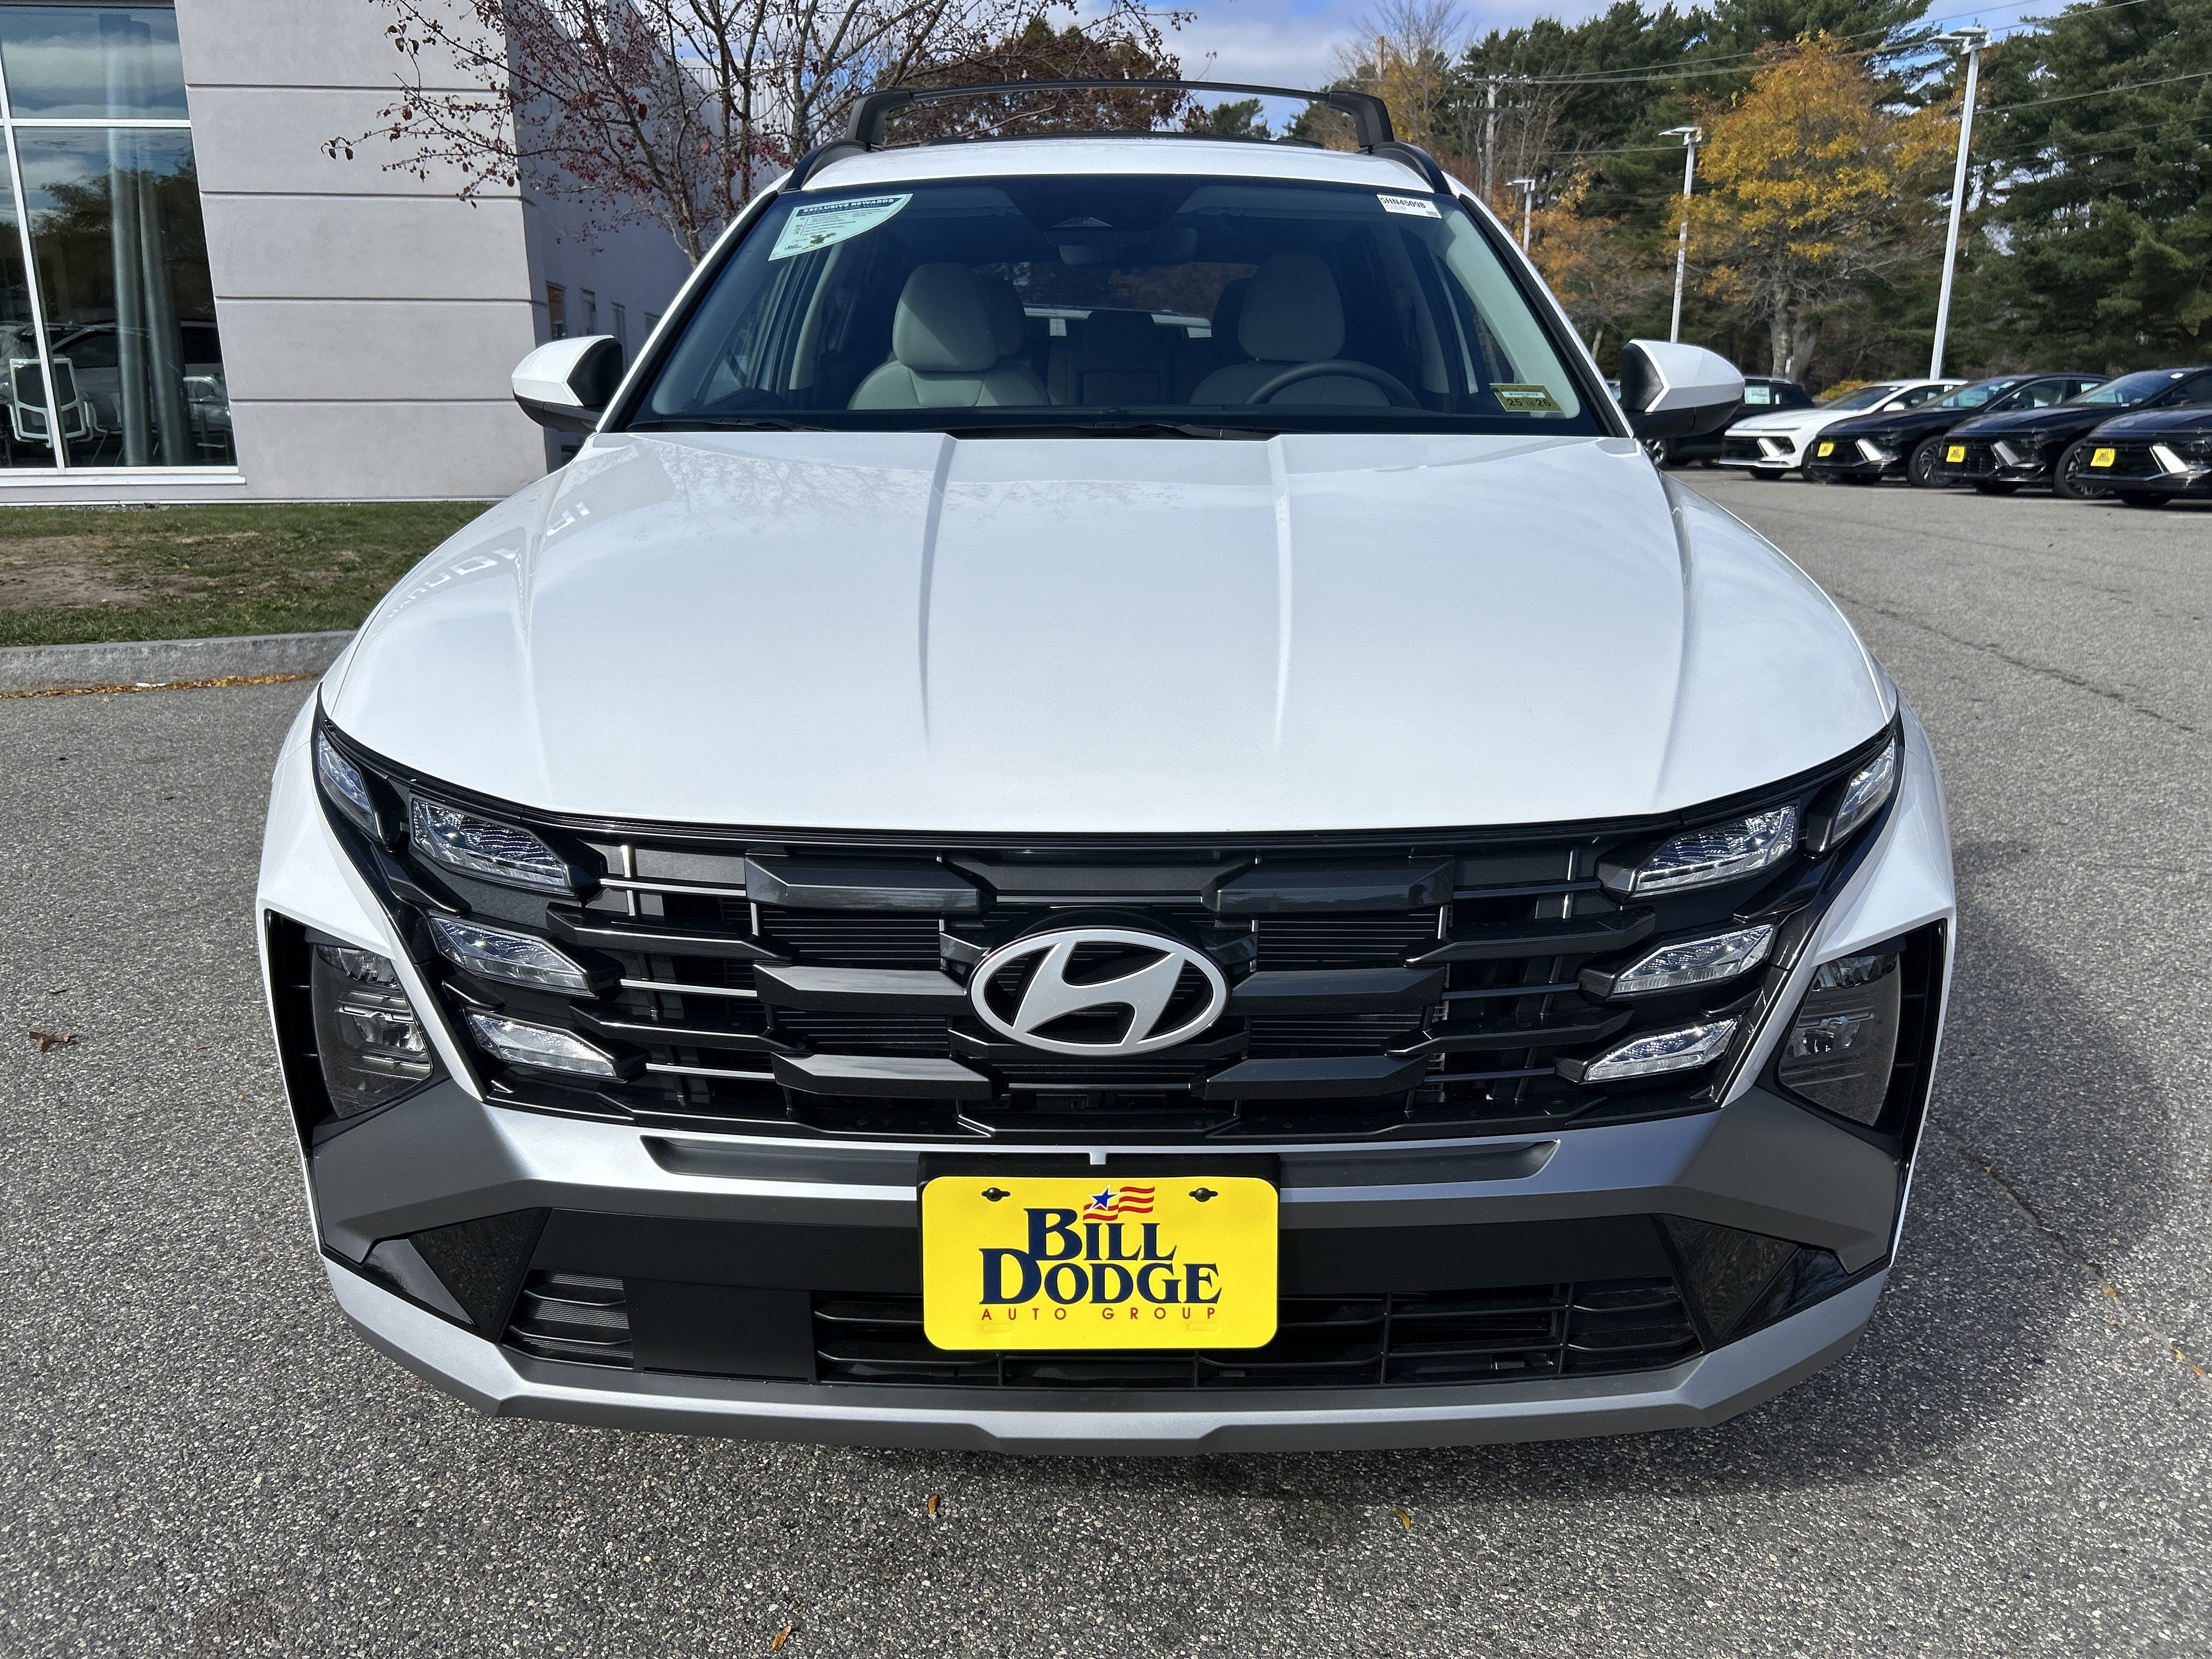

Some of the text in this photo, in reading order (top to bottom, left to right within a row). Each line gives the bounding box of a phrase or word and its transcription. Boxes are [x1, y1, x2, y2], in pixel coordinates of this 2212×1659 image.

[803, 202, 850, 212] EXCLUSIVE
[1506, 398, 1551, 407] 25 26
[1023, 1207, 1177, 1261] BILL
[978, 1248, 1223, 1305] DODGE
[981, 1307, 1216, 1321] AUTO GROUP
